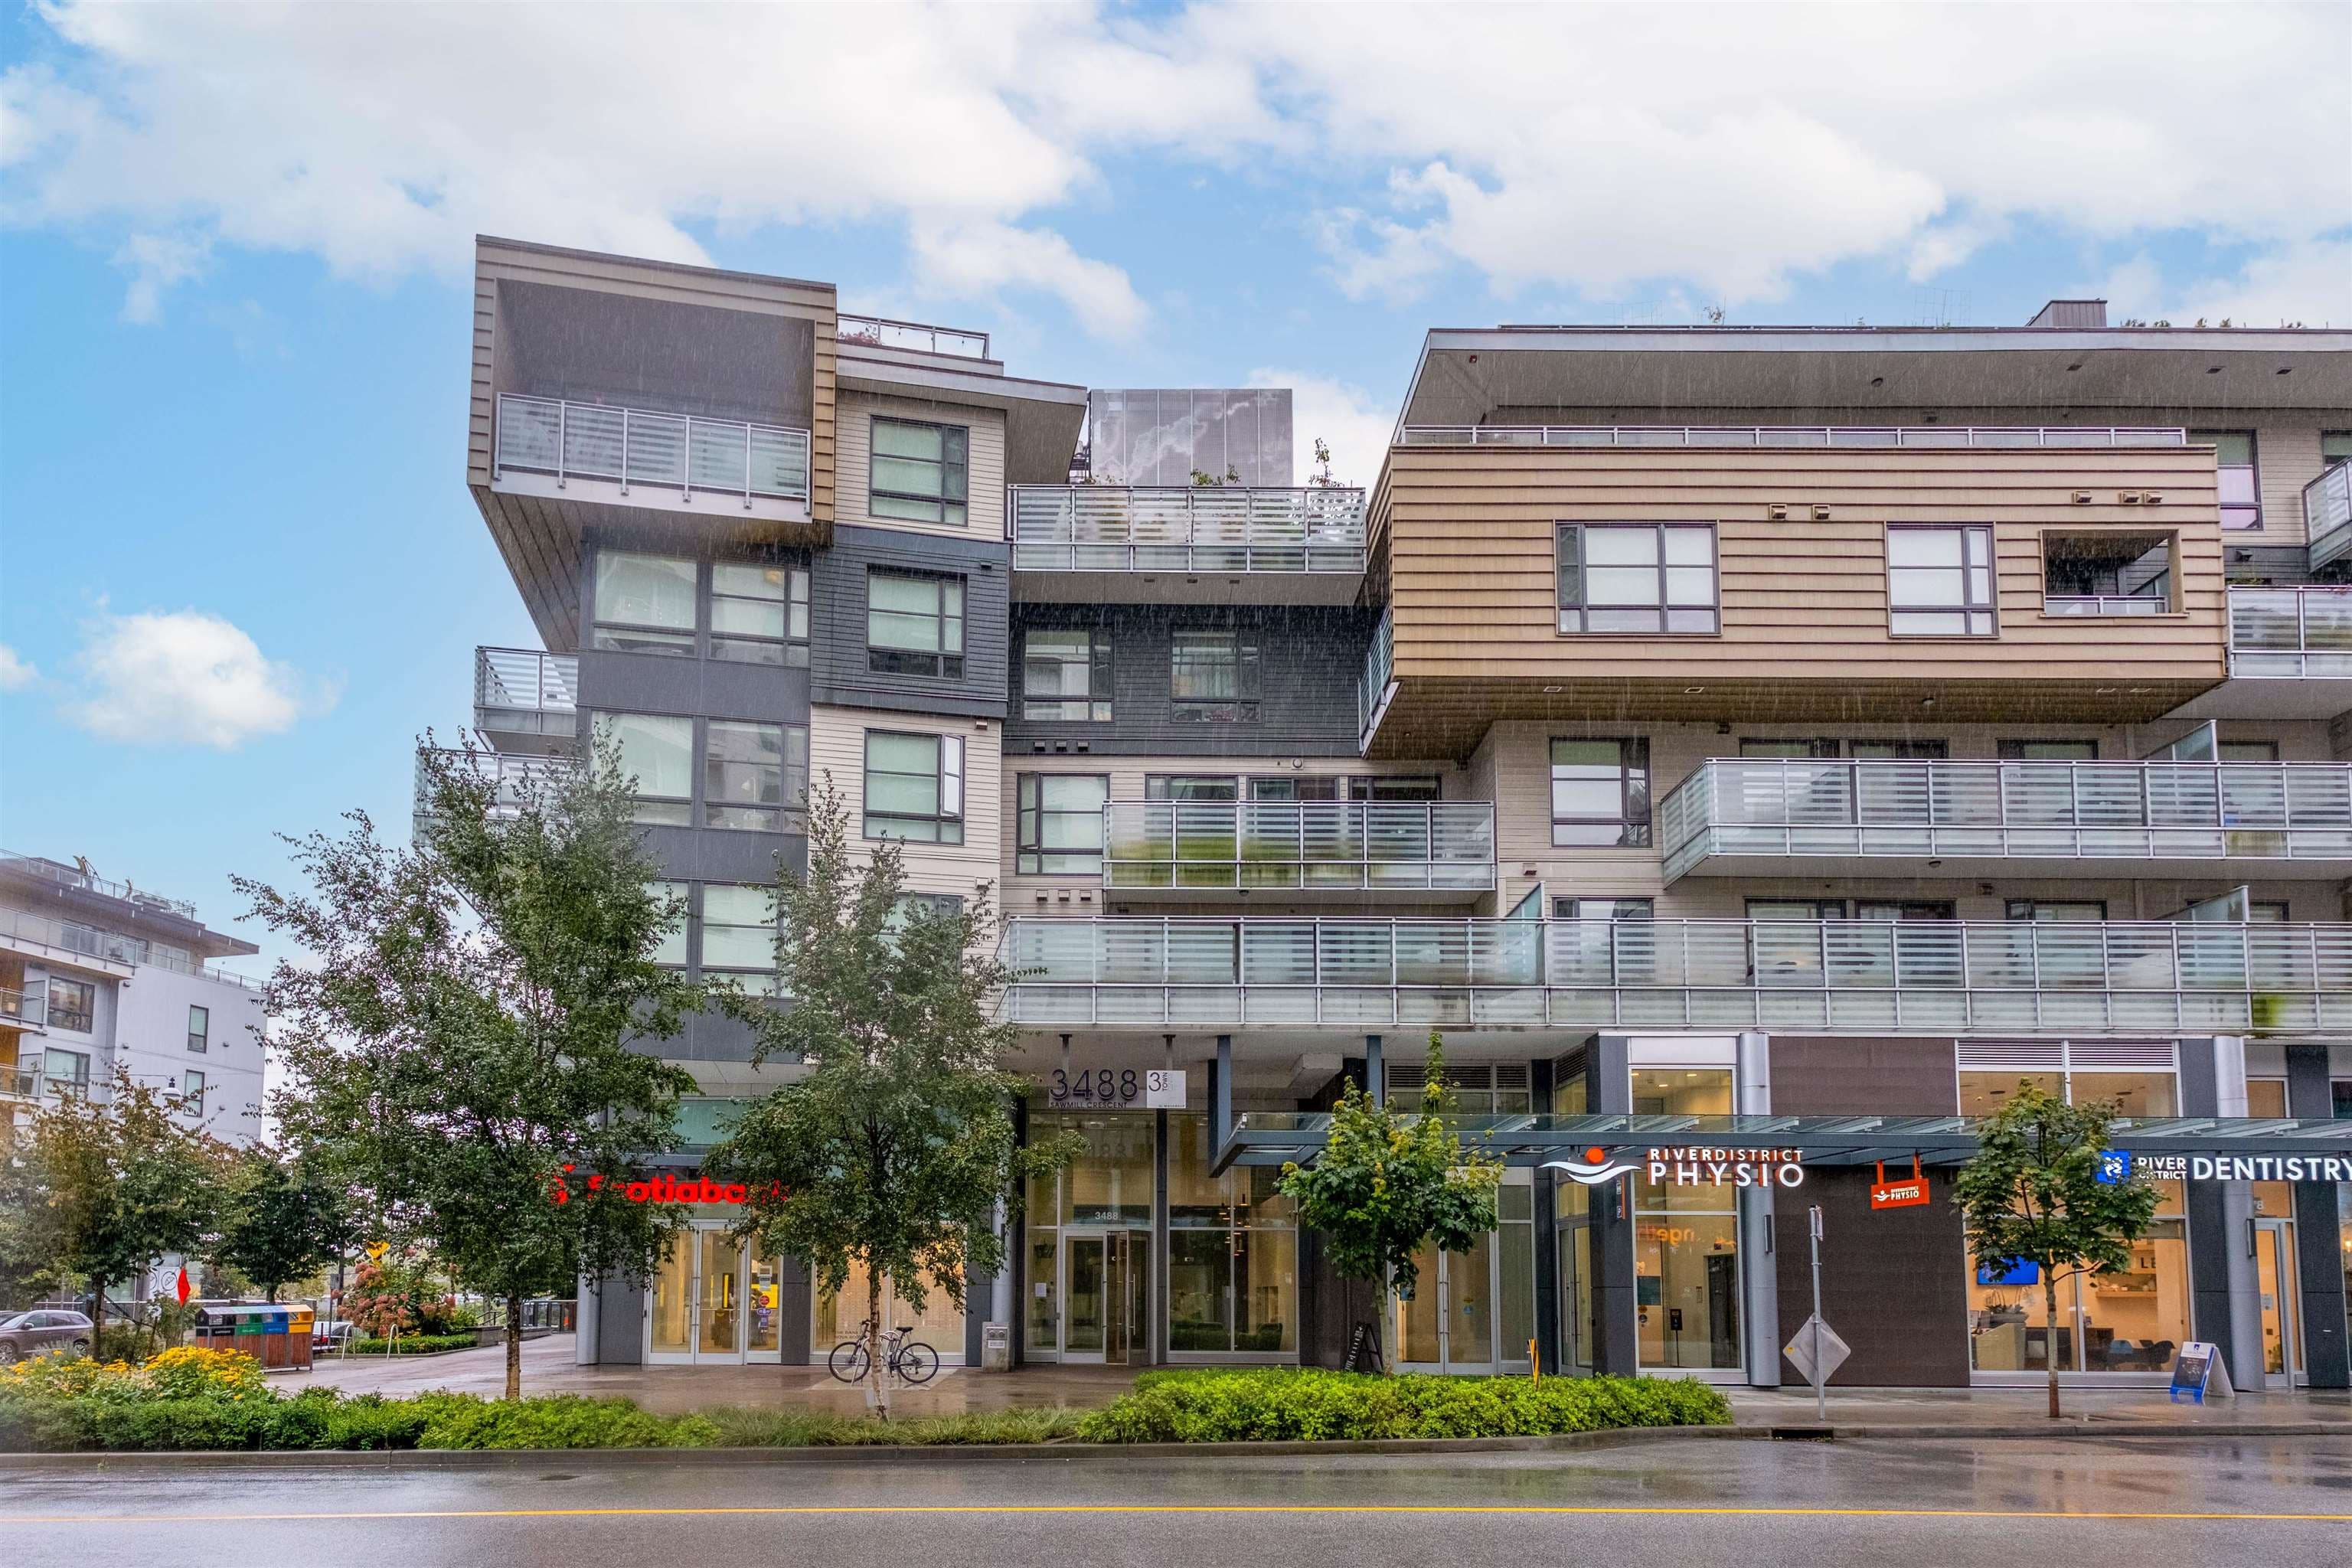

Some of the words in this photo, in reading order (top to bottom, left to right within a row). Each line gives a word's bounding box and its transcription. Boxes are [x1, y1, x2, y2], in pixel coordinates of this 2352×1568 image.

[1050, 1069, 1138, 1100] 3488
[1148, 1072, 1161, 1092] 3
[1648, 1148, 1803, 1162] RIVERDISTRICT
[1648, 1162, 1804, 1187] PHYSIO
[1890, 1191, 1919, 1200] PHYSIO
[1095, 1211, 1119, 1220] 3488
